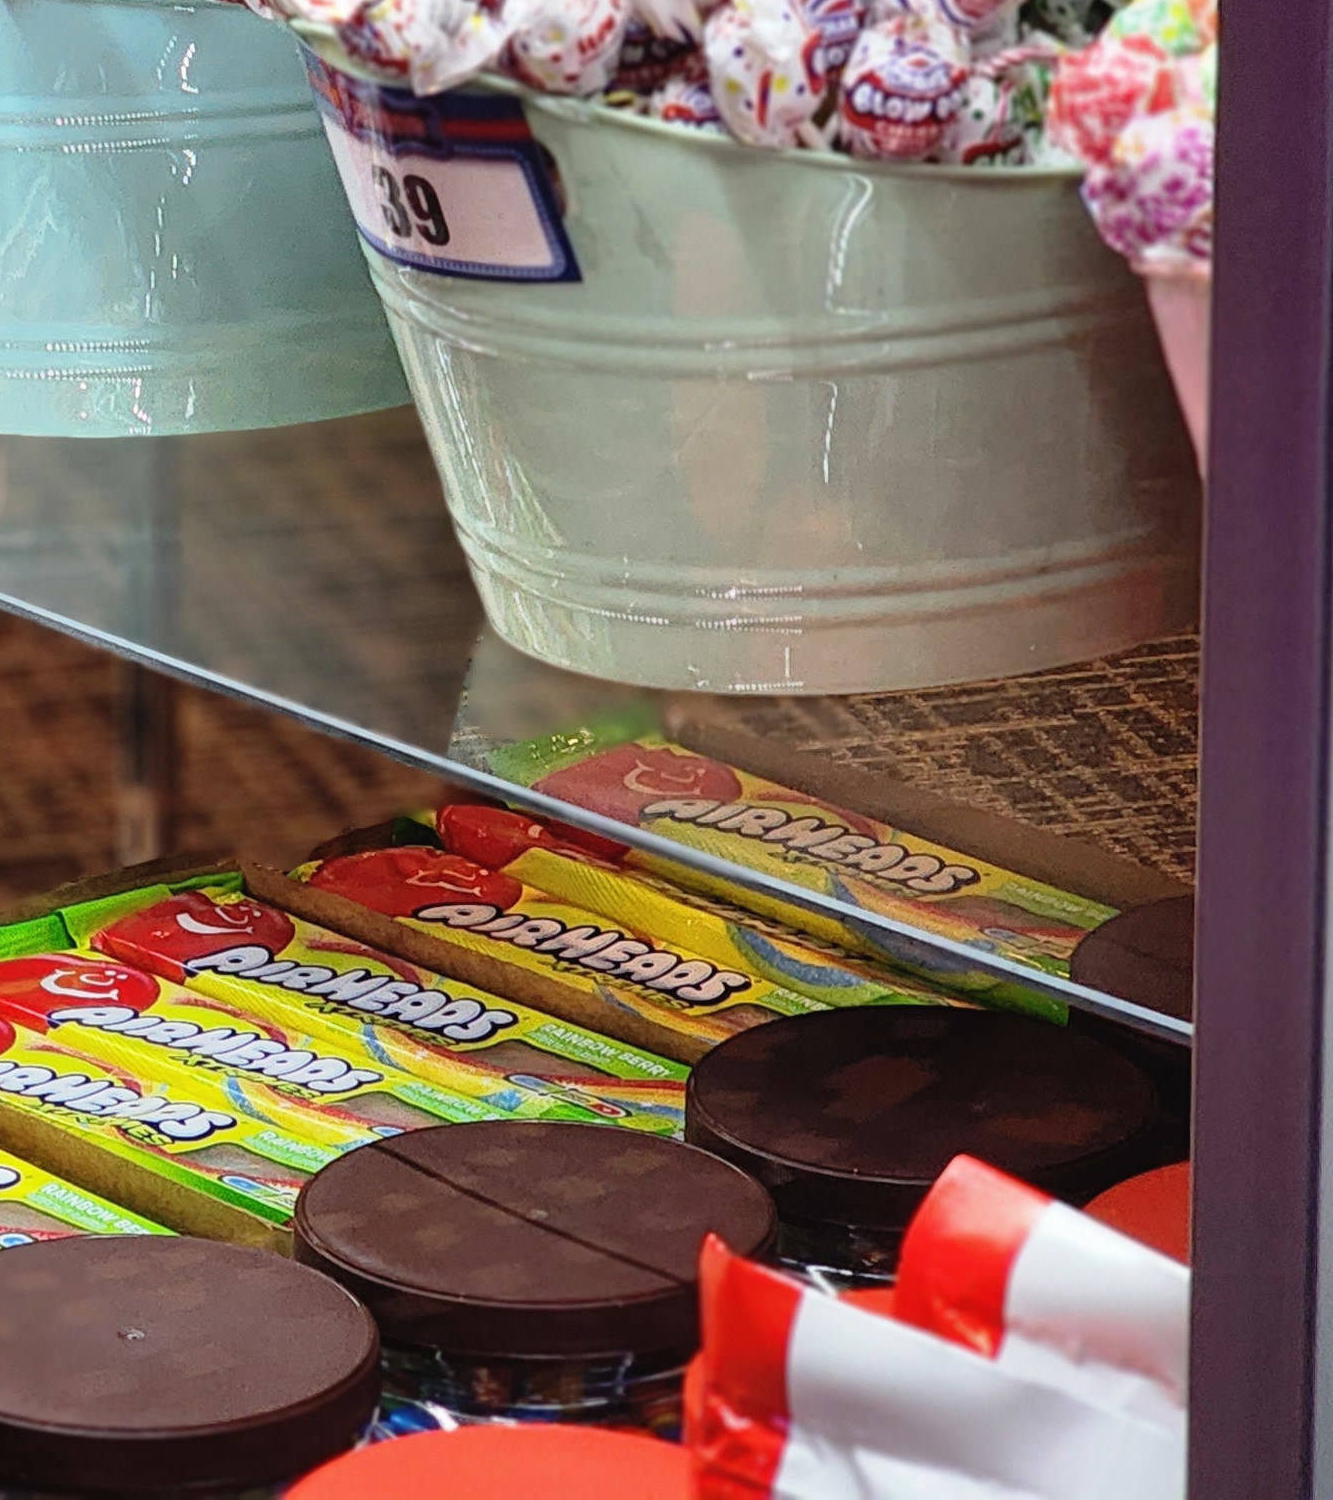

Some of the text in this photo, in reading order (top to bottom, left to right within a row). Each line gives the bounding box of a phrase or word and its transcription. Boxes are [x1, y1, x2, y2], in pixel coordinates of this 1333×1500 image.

[371, 163, 450, 247] 39
[638, 796, 983, 896] AIRHEADS
[189, 946, 519, 1042] AIRHEADS
[415, 900, 752, 1004] AIRHEADS
[47, 1003, 386, 1095] AIRHEADS
[540, 1022, 619, 1058] RAINBOW
[616, 1050, 677, 1079] BERRY
[40, 1182, 116, 1222] RAINBOW
